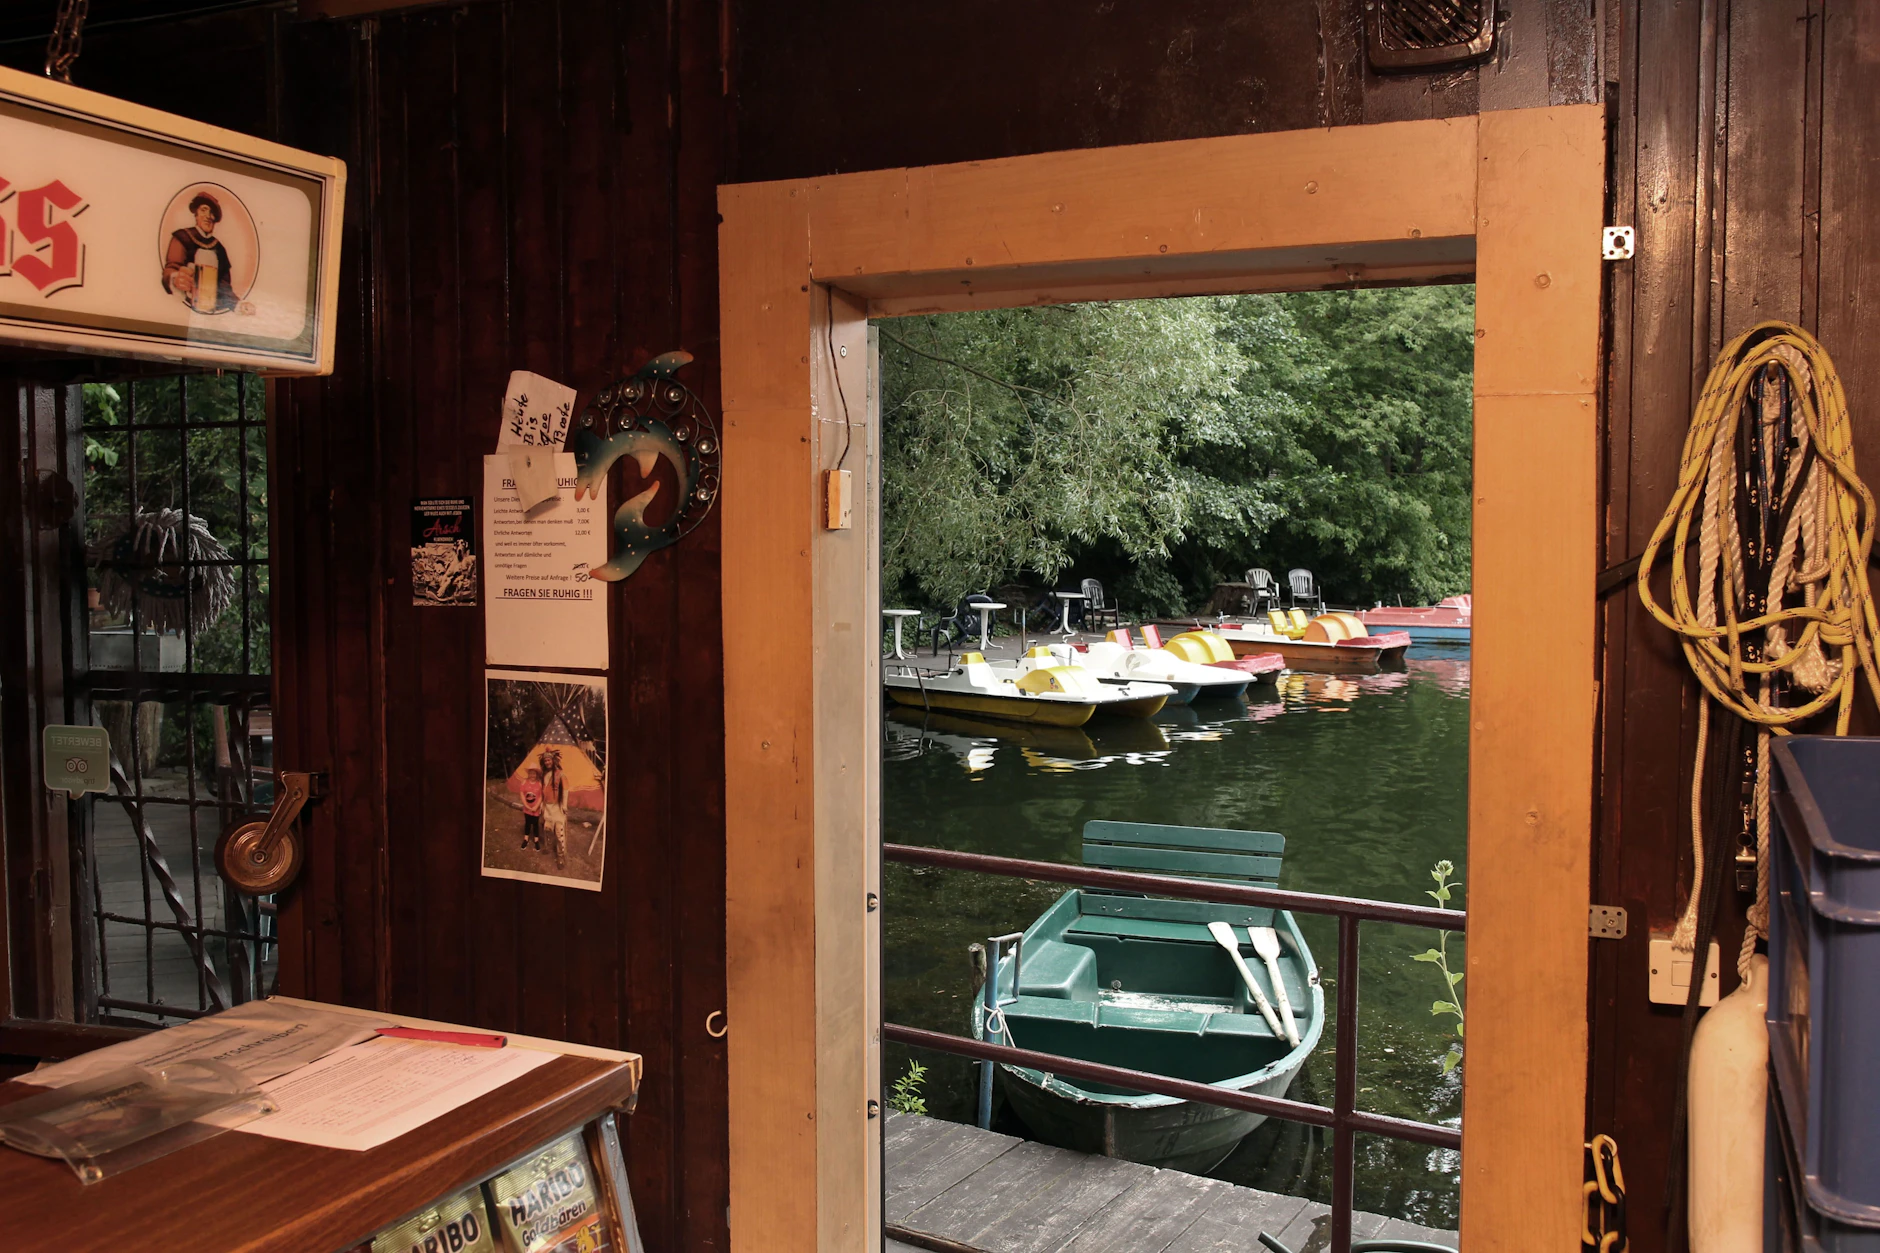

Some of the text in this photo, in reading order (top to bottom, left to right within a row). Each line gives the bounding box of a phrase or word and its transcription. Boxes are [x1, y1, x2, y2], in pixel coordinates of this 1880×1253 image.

[502, 478, 516, 487] FRA
[422, 516, 462, 538] Arsch
[503, 588, 593, 598] FRAGEN SIE RUHIG !!!
[213, 1021, 308, 1061] erschreiben
[510, 1162, 586, 1227] HARIBO
[522, 1200, 587, 1246] Goldbären
